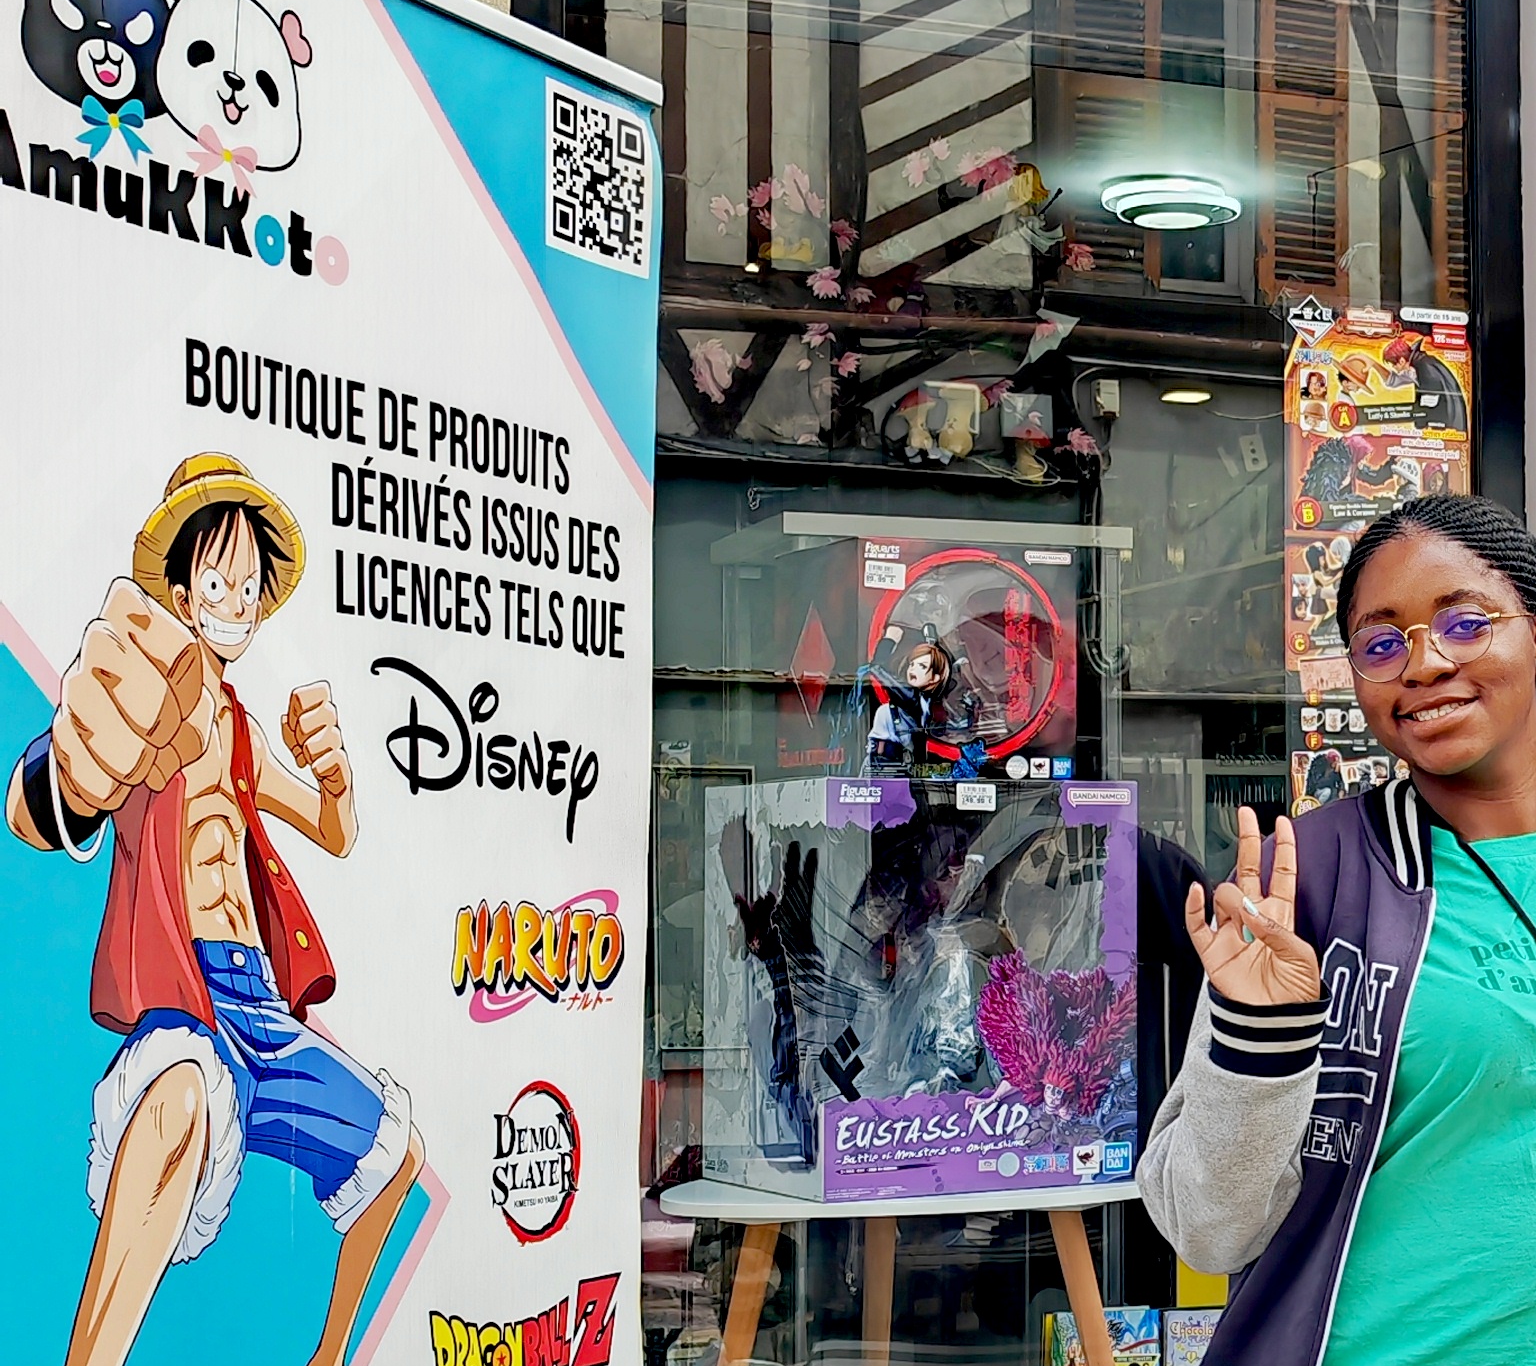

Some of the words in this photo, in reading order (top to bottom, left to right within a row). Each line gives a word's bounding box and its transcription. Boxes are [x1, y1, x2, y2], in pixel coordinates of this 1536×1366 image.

[185, 337, 366, 446] BOUTIQUE
[378, 391, 418, 459] DE
[429, 400, 571, 496] PRODUITS
[330, 457, 473, 552] DÉRIVÉS
[481, 507, 559, 571] ISSUS
[567, 518, 621, 583] DES
[334, 549, 492, 637] LICENCES
[499, 587, 565, 650] TELS
[571, 601, 626, 659] QUE
[840, 784, 882, 798] Figuarts
[1071, 790, 1102, 804] BANDAI
[1103, 791, 1129, 804] NAMCO
[451, 899, 625, 999] NARUTO
[493, 1112, 576, 1160] DEMON
[1106, 1146, 1128, 1159] BAN
[490, 1151, 579, 1209] SLAYER
[1106, 1158, 1124, 1169] DAI
